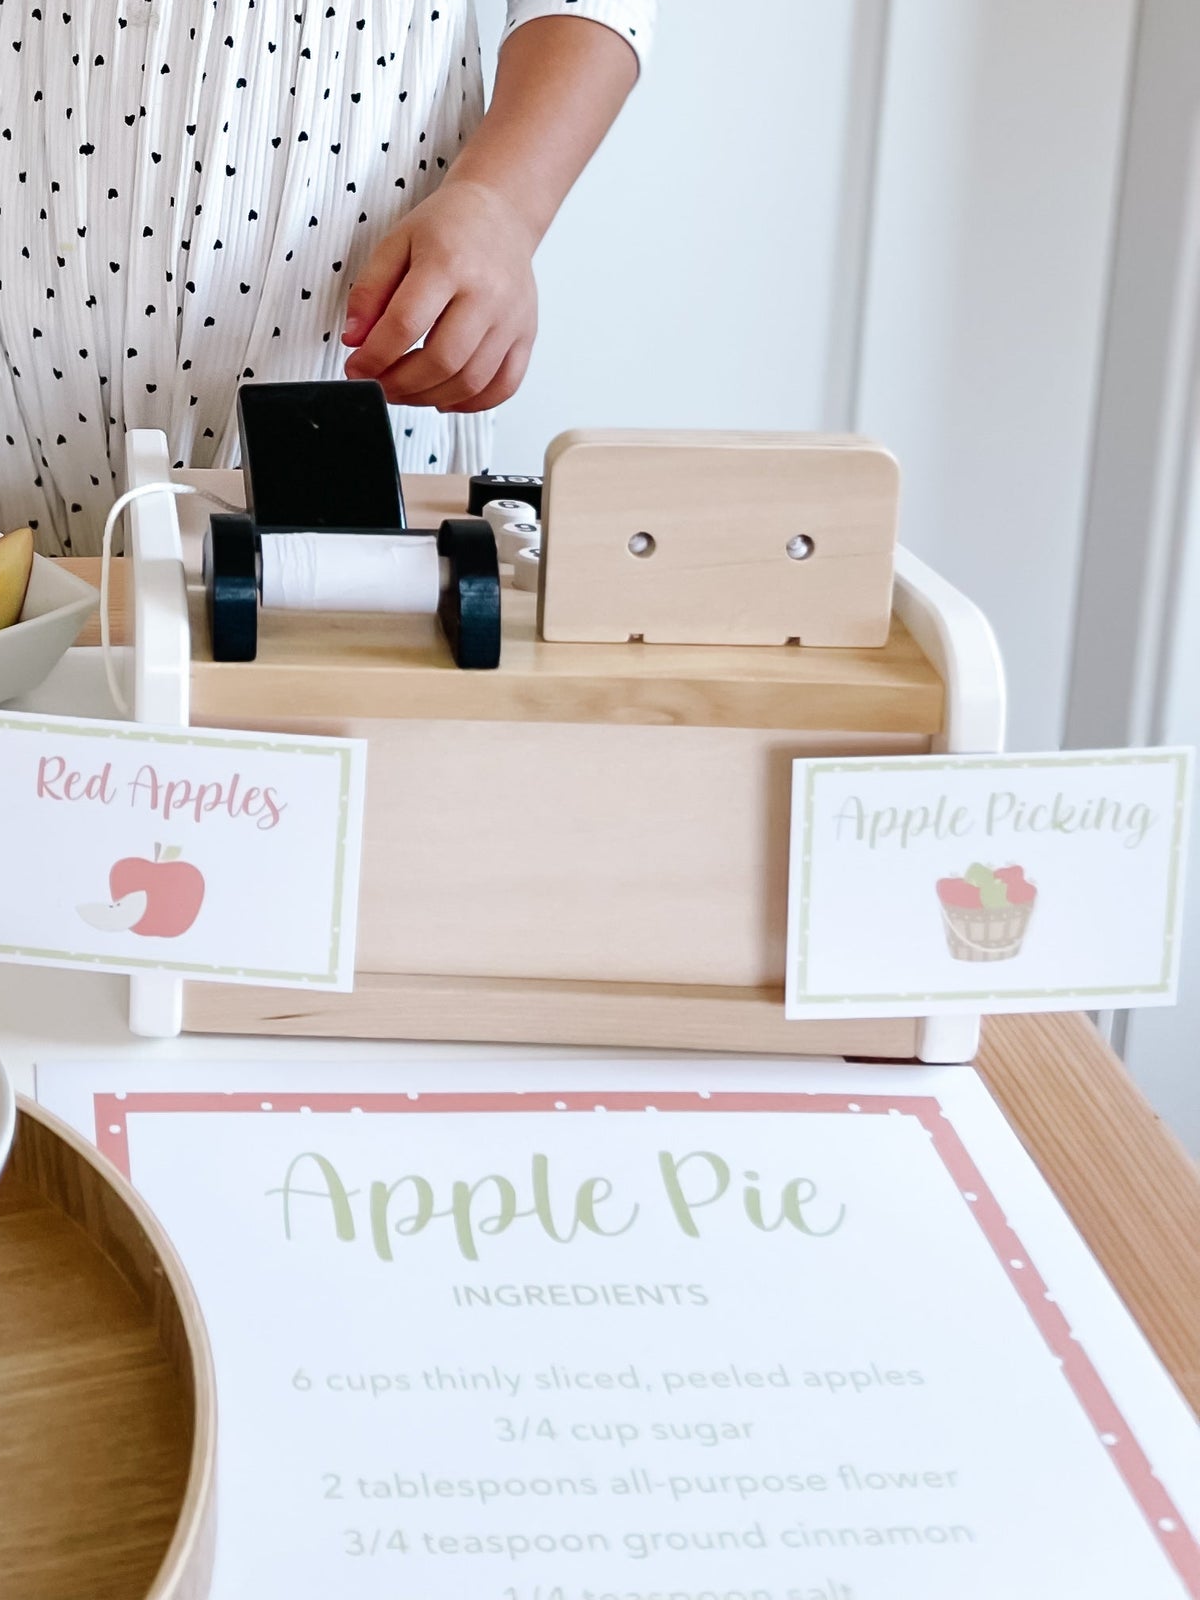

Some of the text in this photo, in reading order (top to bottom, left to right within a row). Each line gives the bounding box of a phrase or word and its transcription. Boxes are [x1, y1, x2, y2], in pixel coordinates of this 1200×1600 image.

[36, 755, 288, 831] Red Apples
[832, 791, 1158, 851] Apple Picking
[264, 1150, 846, 1263] Apple Pie
[452, 1283, 711, 1308] INGREDIENTS
[291, 1362, 926, 1400] 6 cups thinly sliced, peeled apples
[494, 1416, 755, 1448] 3/4 cup sugar
[321, 1463, 959, 1505] 2 tablespoons all-purpose flower
[343, 1521, 976, 1561] 3/4 teaspoon ground cinnamon
